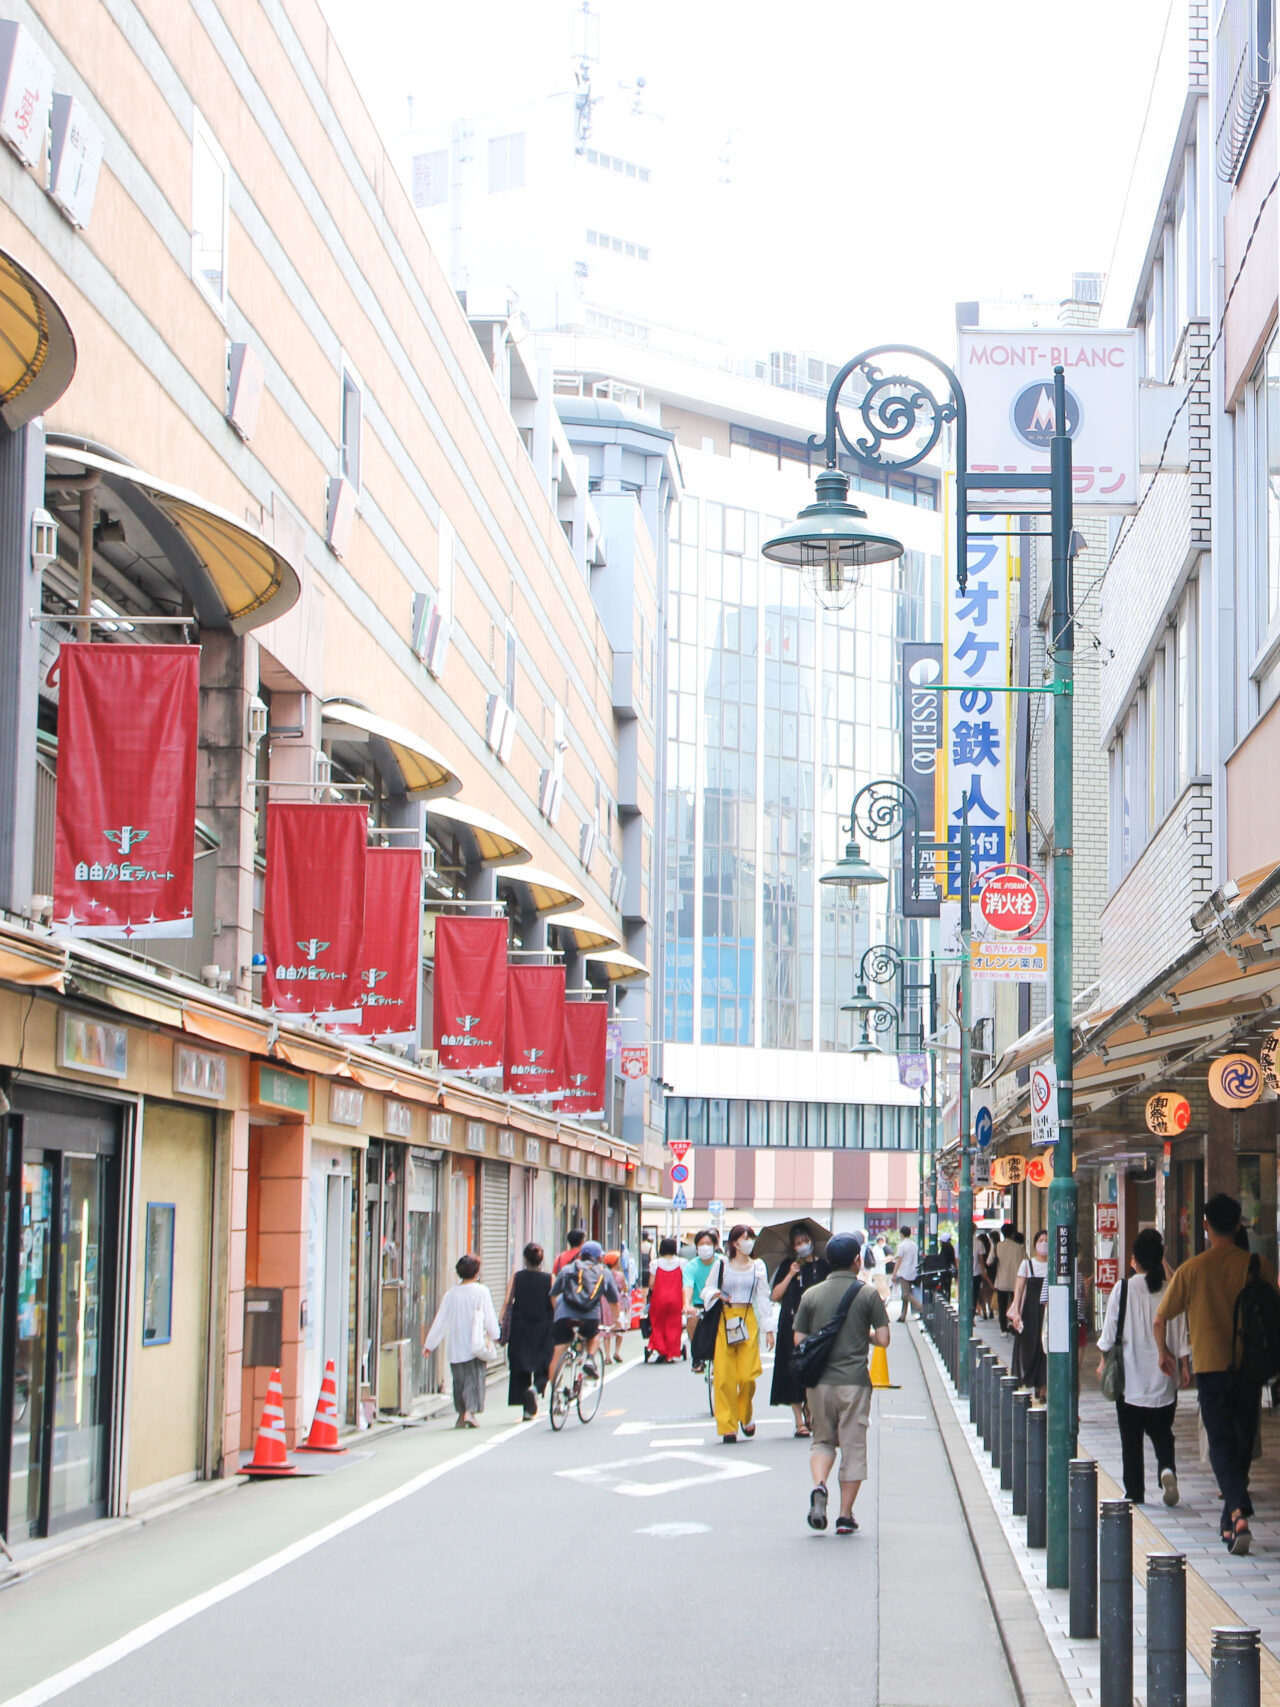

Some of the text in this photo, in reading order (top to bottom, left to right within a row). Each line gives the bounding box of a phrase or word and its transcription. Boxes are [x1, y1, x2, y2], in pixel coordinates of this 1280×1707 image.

[969, 345, 1125, 367] MONT-BLANC
[952, 513, 1001, 822] ラオケの鉄人
[75, 861, 175, 881] 自由が丘デパート
[985, 892, 1033, 915] 消火栓
[984, 944, 1032, 955] 処方せん受付
[276, 965, 348, 981] 自由が丘デパート
[974, 957, 1043, 969] オレンジ薬局
[1149, 1096, 1169, 1134] 御祭禮
